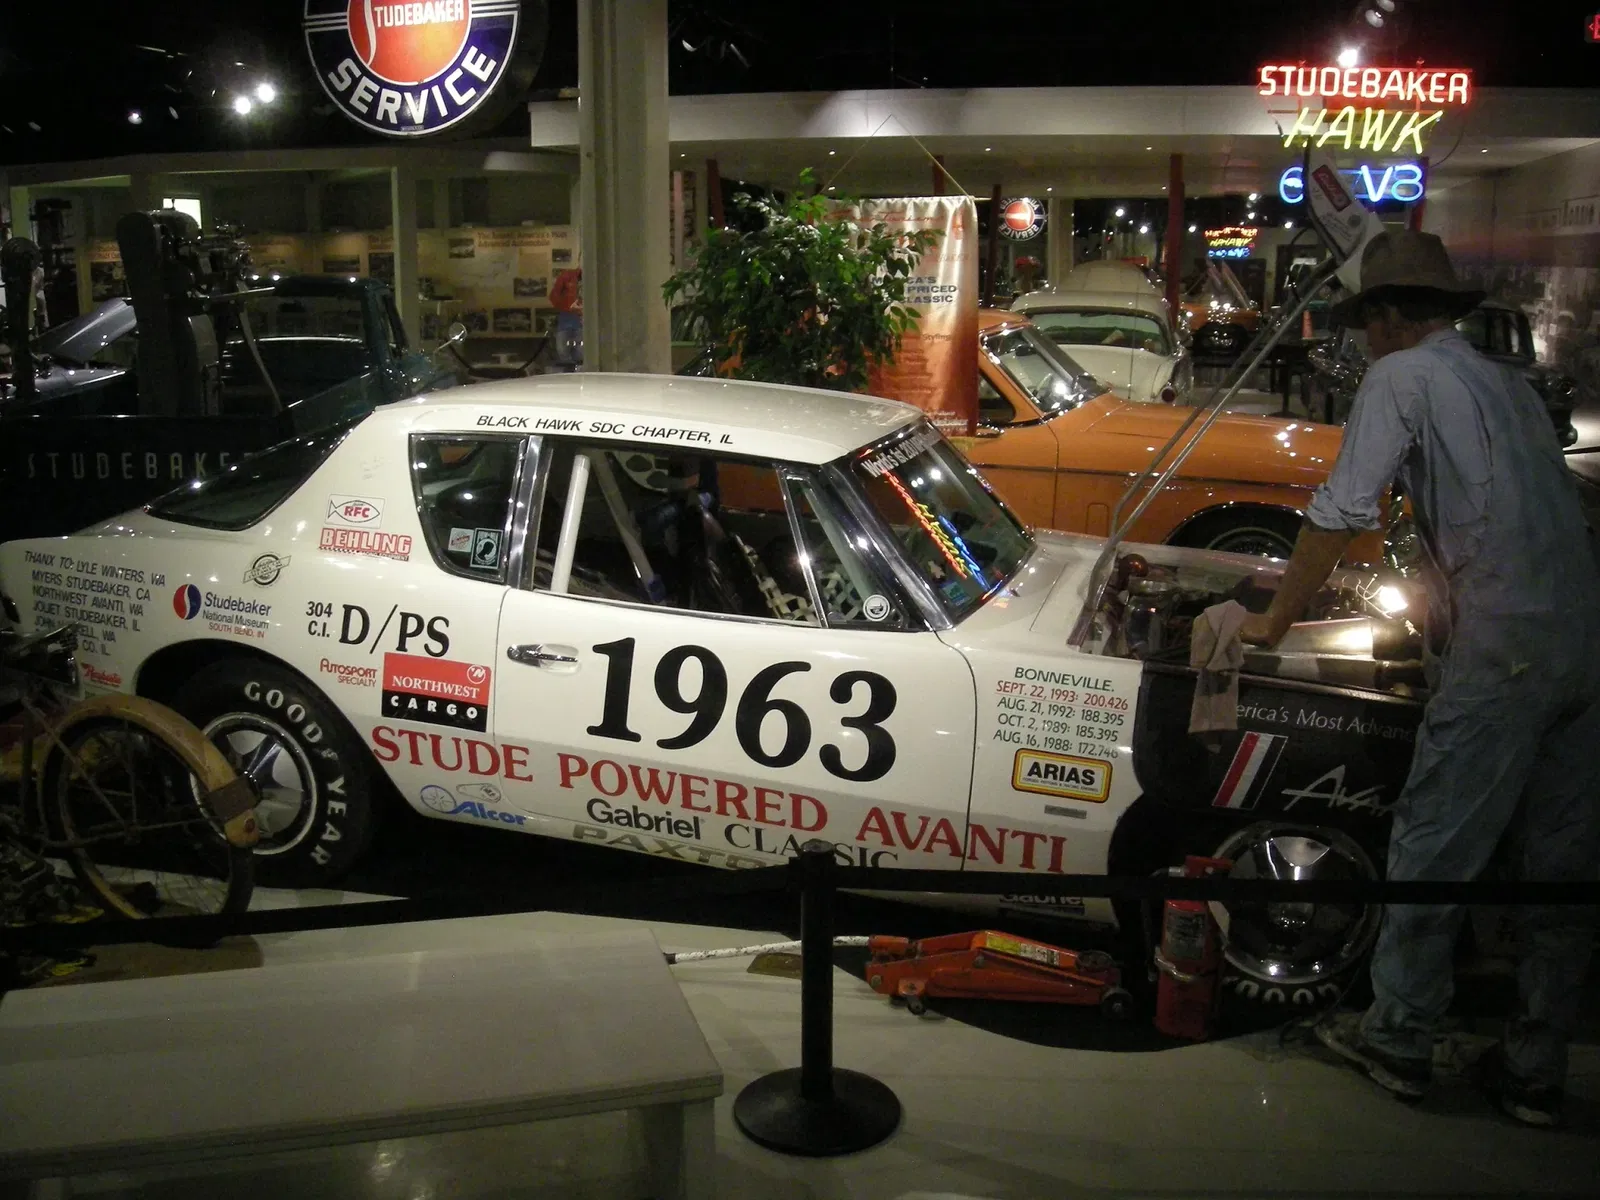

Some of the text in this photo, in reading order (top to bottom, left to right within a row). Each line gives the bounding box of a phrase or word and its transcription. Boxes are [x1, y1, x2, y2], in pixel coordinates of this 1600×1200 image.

[328, 45, 497, 125] SERVICE
[1259, 65, 1469, 104] STUDEBAKER
[1283, 105, 1444, 154] HAWK
[1360, 164, 1424, 203] V8
[906, 285, 958, 293] PRICED
[476, 415, 734, 445] BLACK HAWK SDC CHAPTER, IL
[344, 505, 371, 518] RFC
[320, 527, 413, 555] BEHLING
[24, 551, 56, 567] THANX
[60, 557, 75, 570] TO:
[76, 560, 98, 575] LYLE
[150, 573, 166, 587] WA
[31, 569, 63, 586] MYERS
[136, 588, 151, 602] CA
[32, 584, 88, 608] NORTHWEST
[129, 603, 144, 617] WA
[33, 600, 61, 616] JOLIET
[132, 619, 141, 632] IL
[202, 609, 270, 629] National Museum
[204, 591, 272, 617] Studebaker
[305, 601, 333, 618] 304
[101, 629, 117, 643] WA
[208, 622, 232, 633] SOUTH
[256, 630, 265, 639] IN
[307, 620, 331, 638] C.I.
[338, 603, 450, 658] D/PS
[337, 675, 378, 688] SPECIALTY
[391, 675, 481, 700] NORTHWEST
[995, 680, 1129, 711] SEPT. 22, 1993: 200.426
[389, 695, 479, 720] CARGO
[586, 636, 898, 783] 1963
[996, 696, 1125, 726] AUG. 21, 1992: 188.395
[1236, 702, 1416, 742] erica's Most Advanc
[993, 729, 1023, 745] AUG.
[1026, 734, 1041, 749] 16,
[1043, 737, 1073, 751] 1988:
[997, 713, 1119, 742] OCT. 2, 1989: 185.395
[1027, 761, 1096, 786] ARIAS
[371, 725, 1068, 873] STUDE POWERED AVANTI
[443, 800, 528, 826] Alcor
[586, 798, 702, 840] Gabriel
[724, 823, 899, 869] CLASIC
